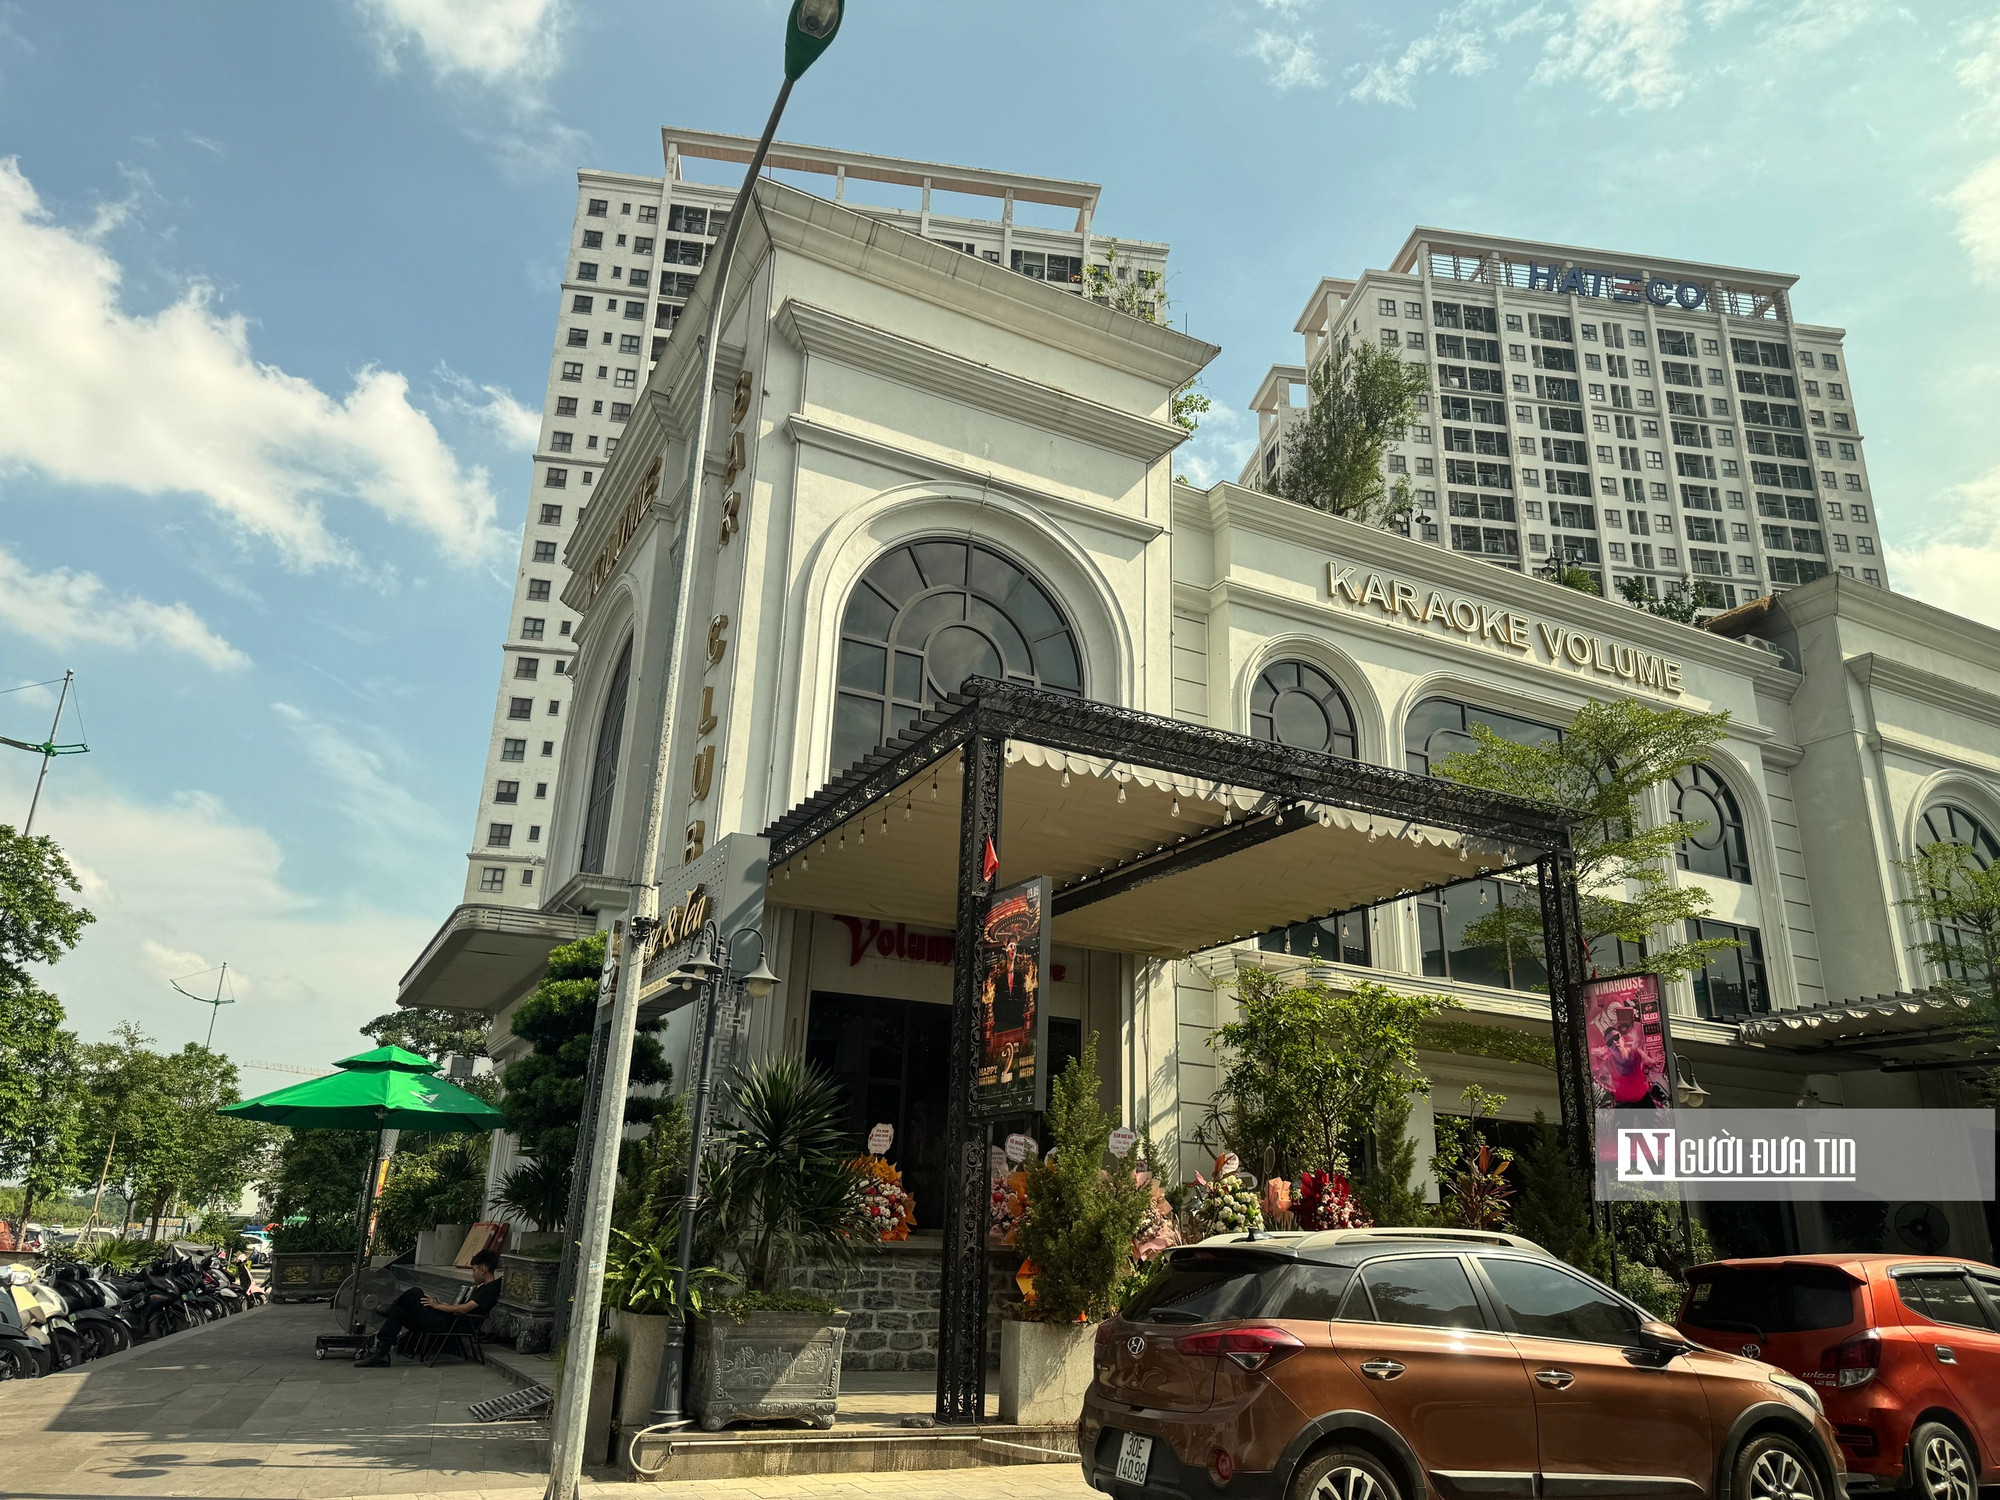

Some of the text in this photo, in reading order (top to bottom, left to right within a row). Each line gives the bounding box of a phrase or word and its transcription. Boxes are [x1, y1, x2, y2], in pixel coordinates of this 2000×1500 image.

[684, 371, 752, 867] BAR CLUB
[1326, 560, 1686, 694] KARAOKE VOLUME
[680, 883, 713, 940] Tea
[832, 914, 957, 969] Volum
[1593, 976, 1645, 996] VINAHOUSE
[978, 1065, 998, 1077] HAPPY
[1126, 1437, 1145, 1459] 30E
[1118, 1456, 1146, 1484] 140.98
